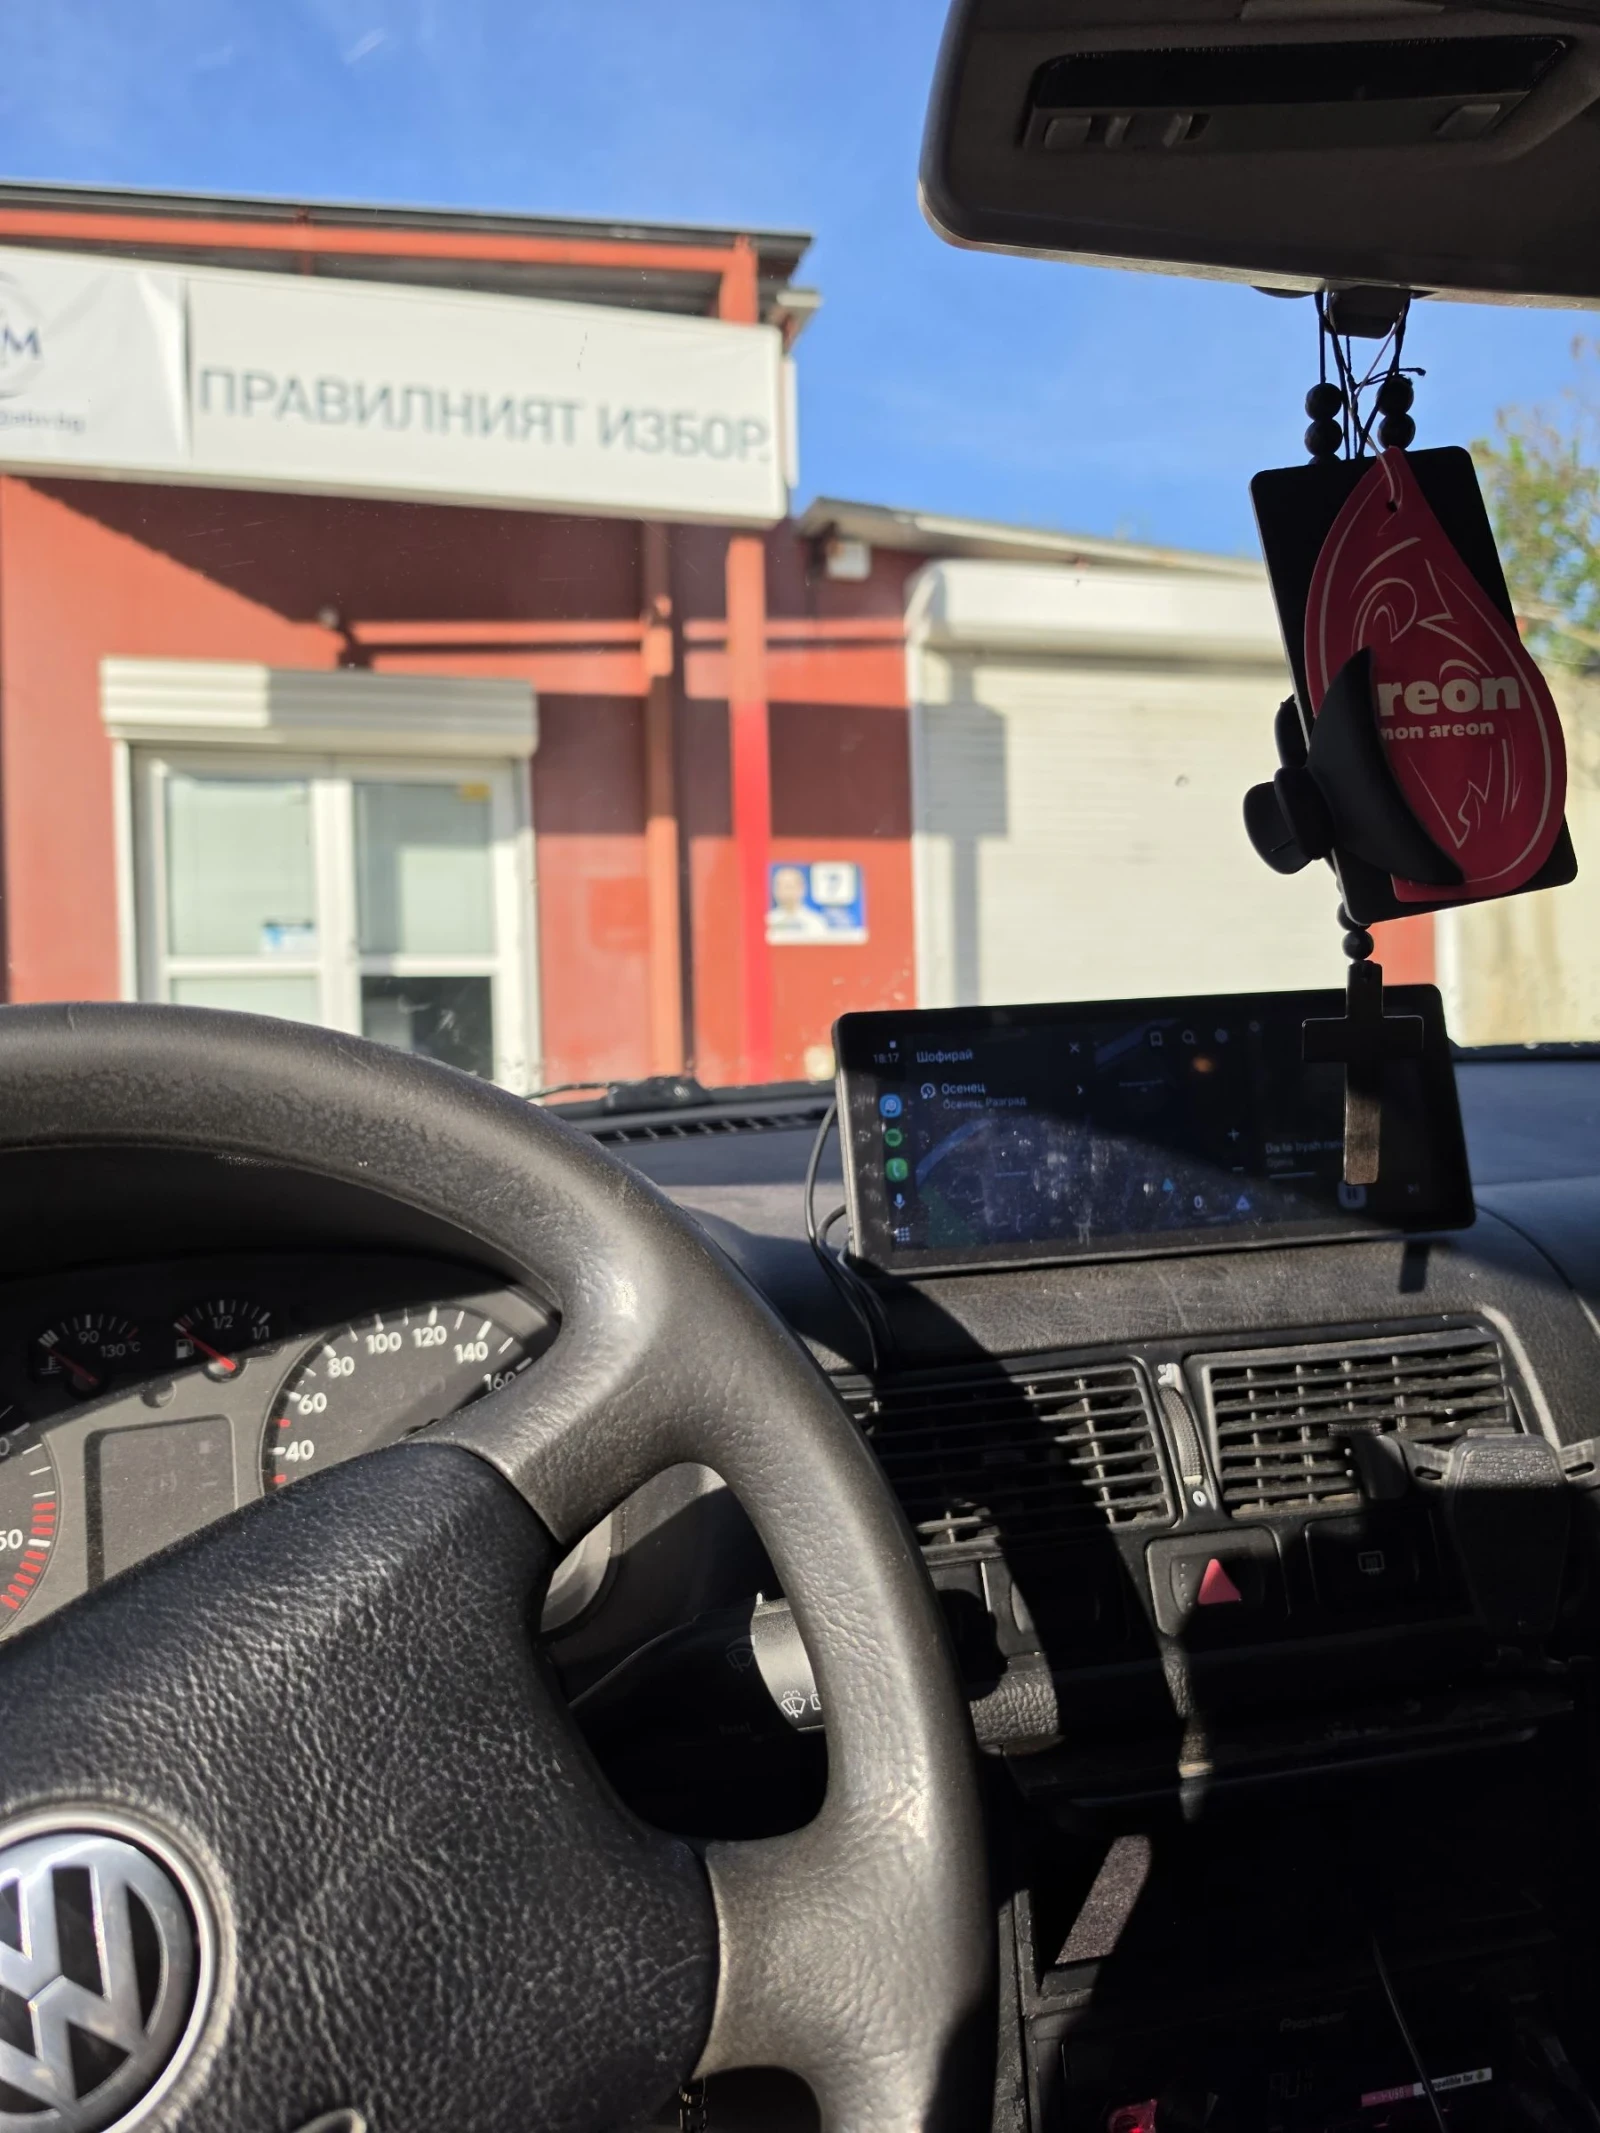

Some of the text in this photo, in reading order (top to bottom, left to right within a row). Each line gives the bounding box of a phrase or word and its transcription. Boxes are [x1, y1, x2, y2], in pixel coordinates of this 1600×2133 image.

[199, 364, 584, 446] ПРАВИЛНИЯТ
[1377, 676, 1521, 717] reon
[1429, 722, 1495, 738] areon
[916, 1049, 974, 1064] Шофирай
[941, 1082, 986, 1095] Осенец
[78, 1330, 100, 1345] 90
[213, 1315, 270, 1340] 1/2 1/1
[412, 1325, 447, 1348] 120
[366, 1331, 402, 1355] 100
[454, 1340, 489, 1364] 140
[327, 1355, 355, 1379] 80
[298, 1392, 328, 1416] 60
[285, 1439, 315, 1463] 40
